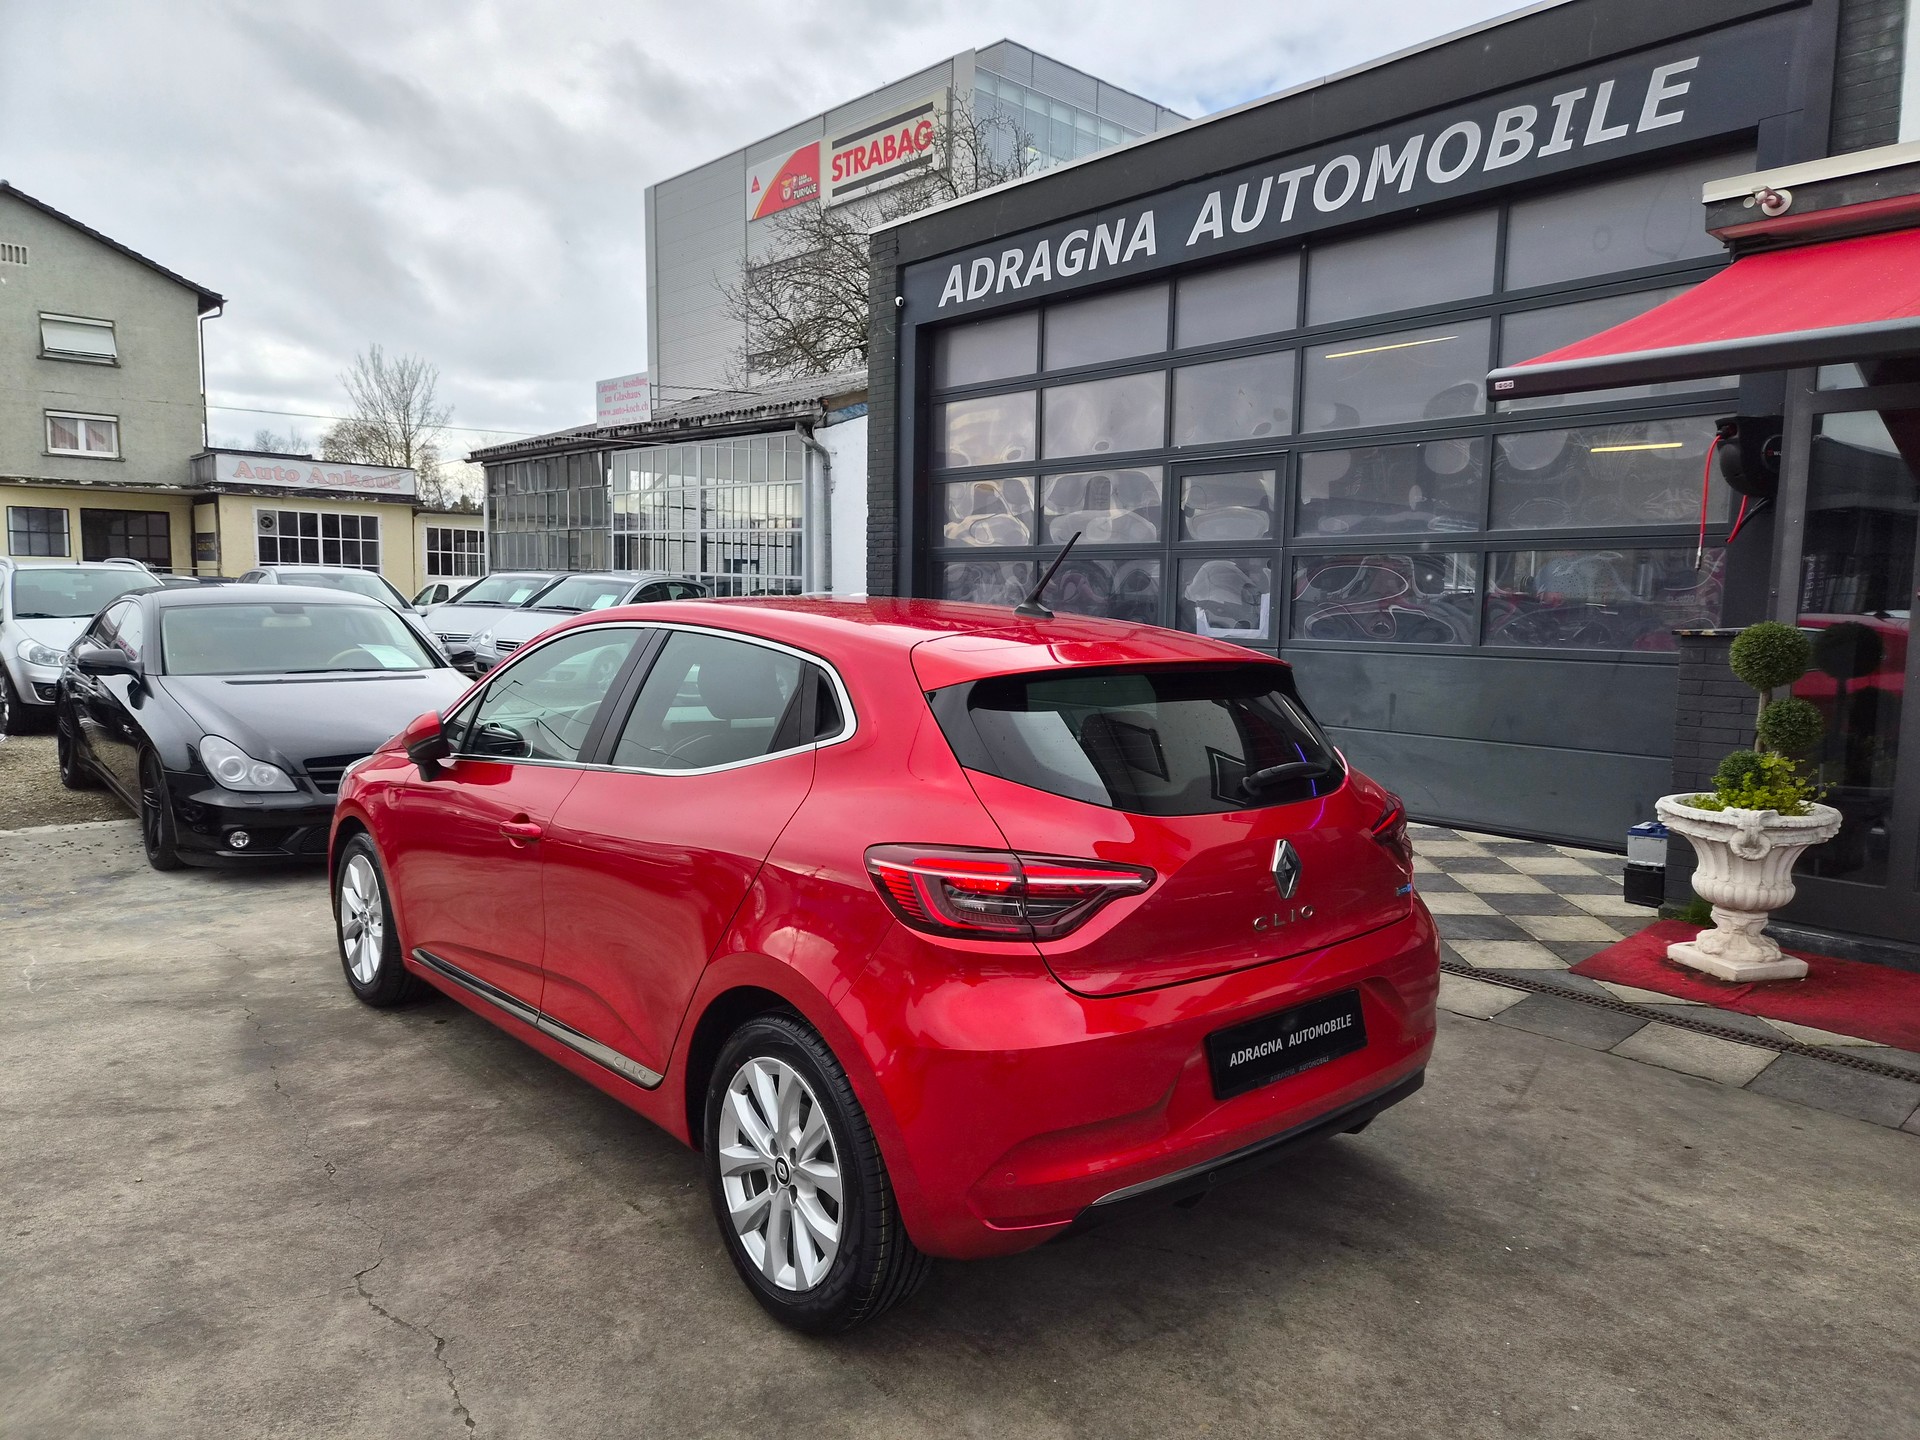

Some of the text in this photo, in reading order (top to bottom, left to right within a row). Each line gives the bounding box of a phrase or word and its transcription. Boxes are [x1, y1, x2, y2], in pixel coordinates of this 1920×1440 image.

[831, 120, 934, 182] STRABAG
[938, 56, 1700, 307] ADRAGNA AUTOMOBILE
[233, 460, 299, 482] Auto
[1253, 905, 1314, 931] CLIO
[1229, 1013, 1352, 1068] ADRAGNA AUTOMOBILE
[613, 1056, 646, 1080] CLIO
